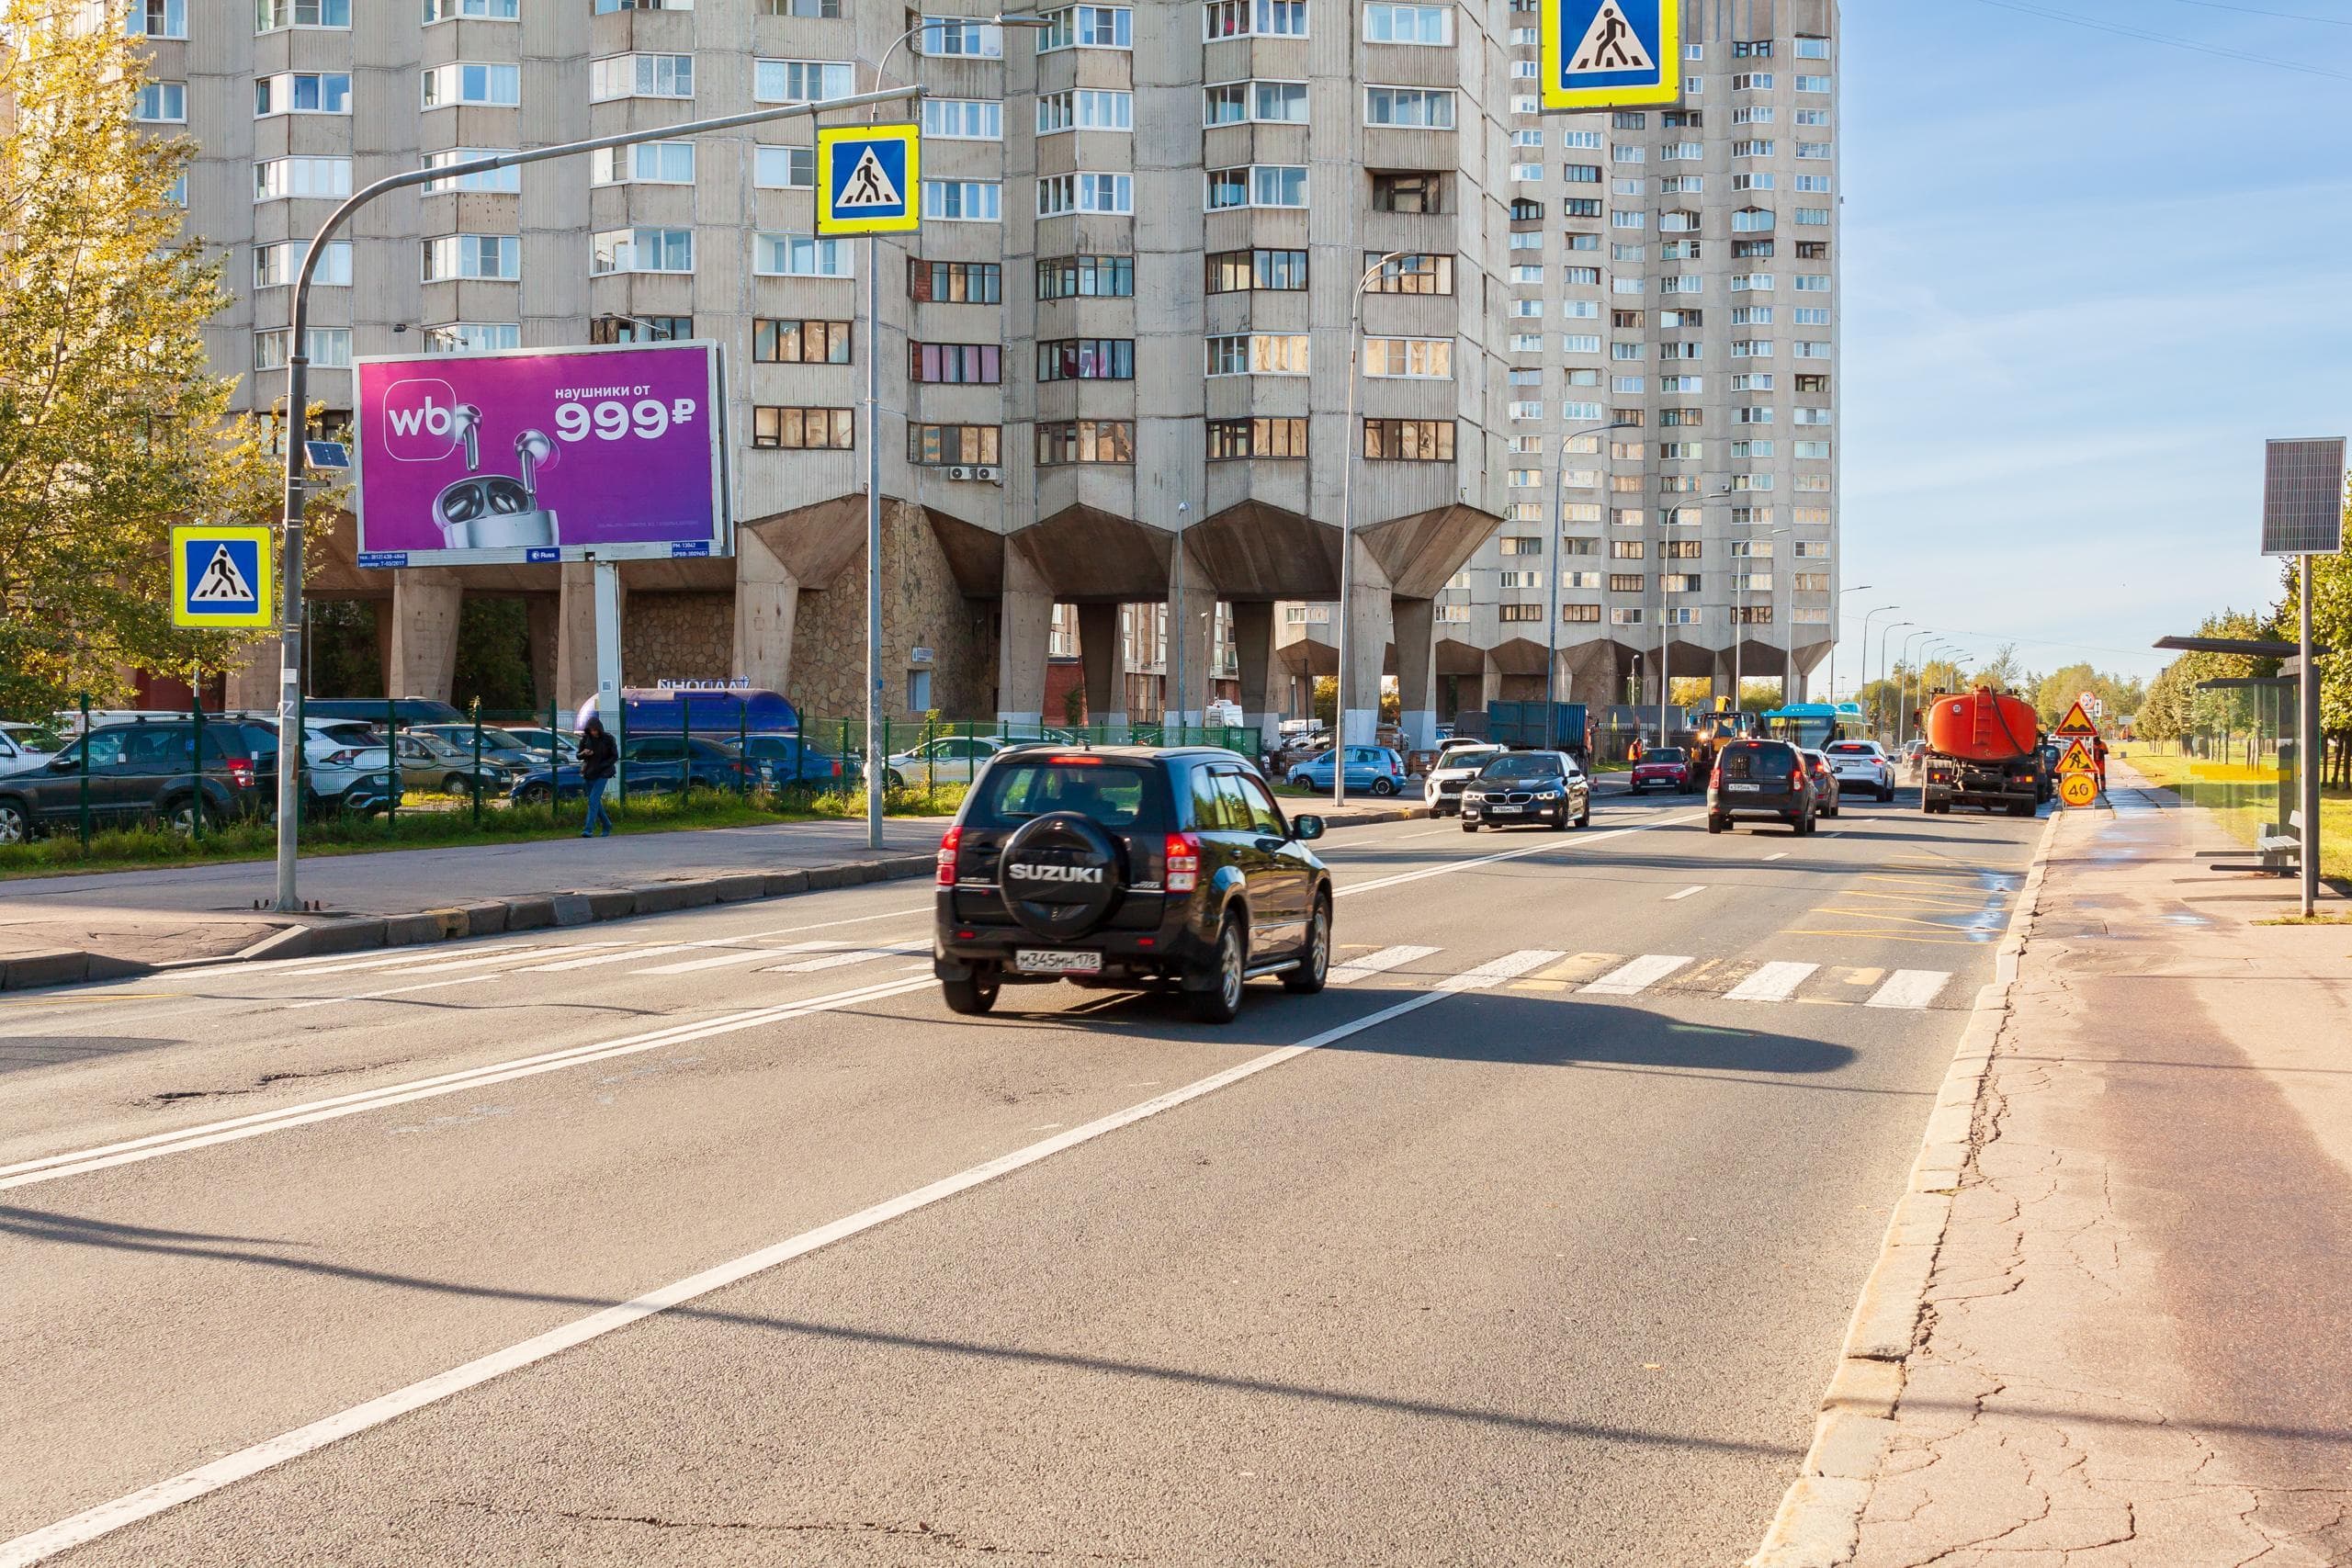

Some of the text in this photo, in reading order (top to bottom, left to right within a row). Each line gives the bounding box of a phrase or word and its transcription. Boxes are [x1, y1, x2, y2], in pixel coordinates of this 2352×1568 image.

[555, 385, 650, 400] наушники от
[388, 396, 451, 436] wb
[2068, 783, 2089, 797] 40
[1009, 863, 1103, 884] SUZUKI
